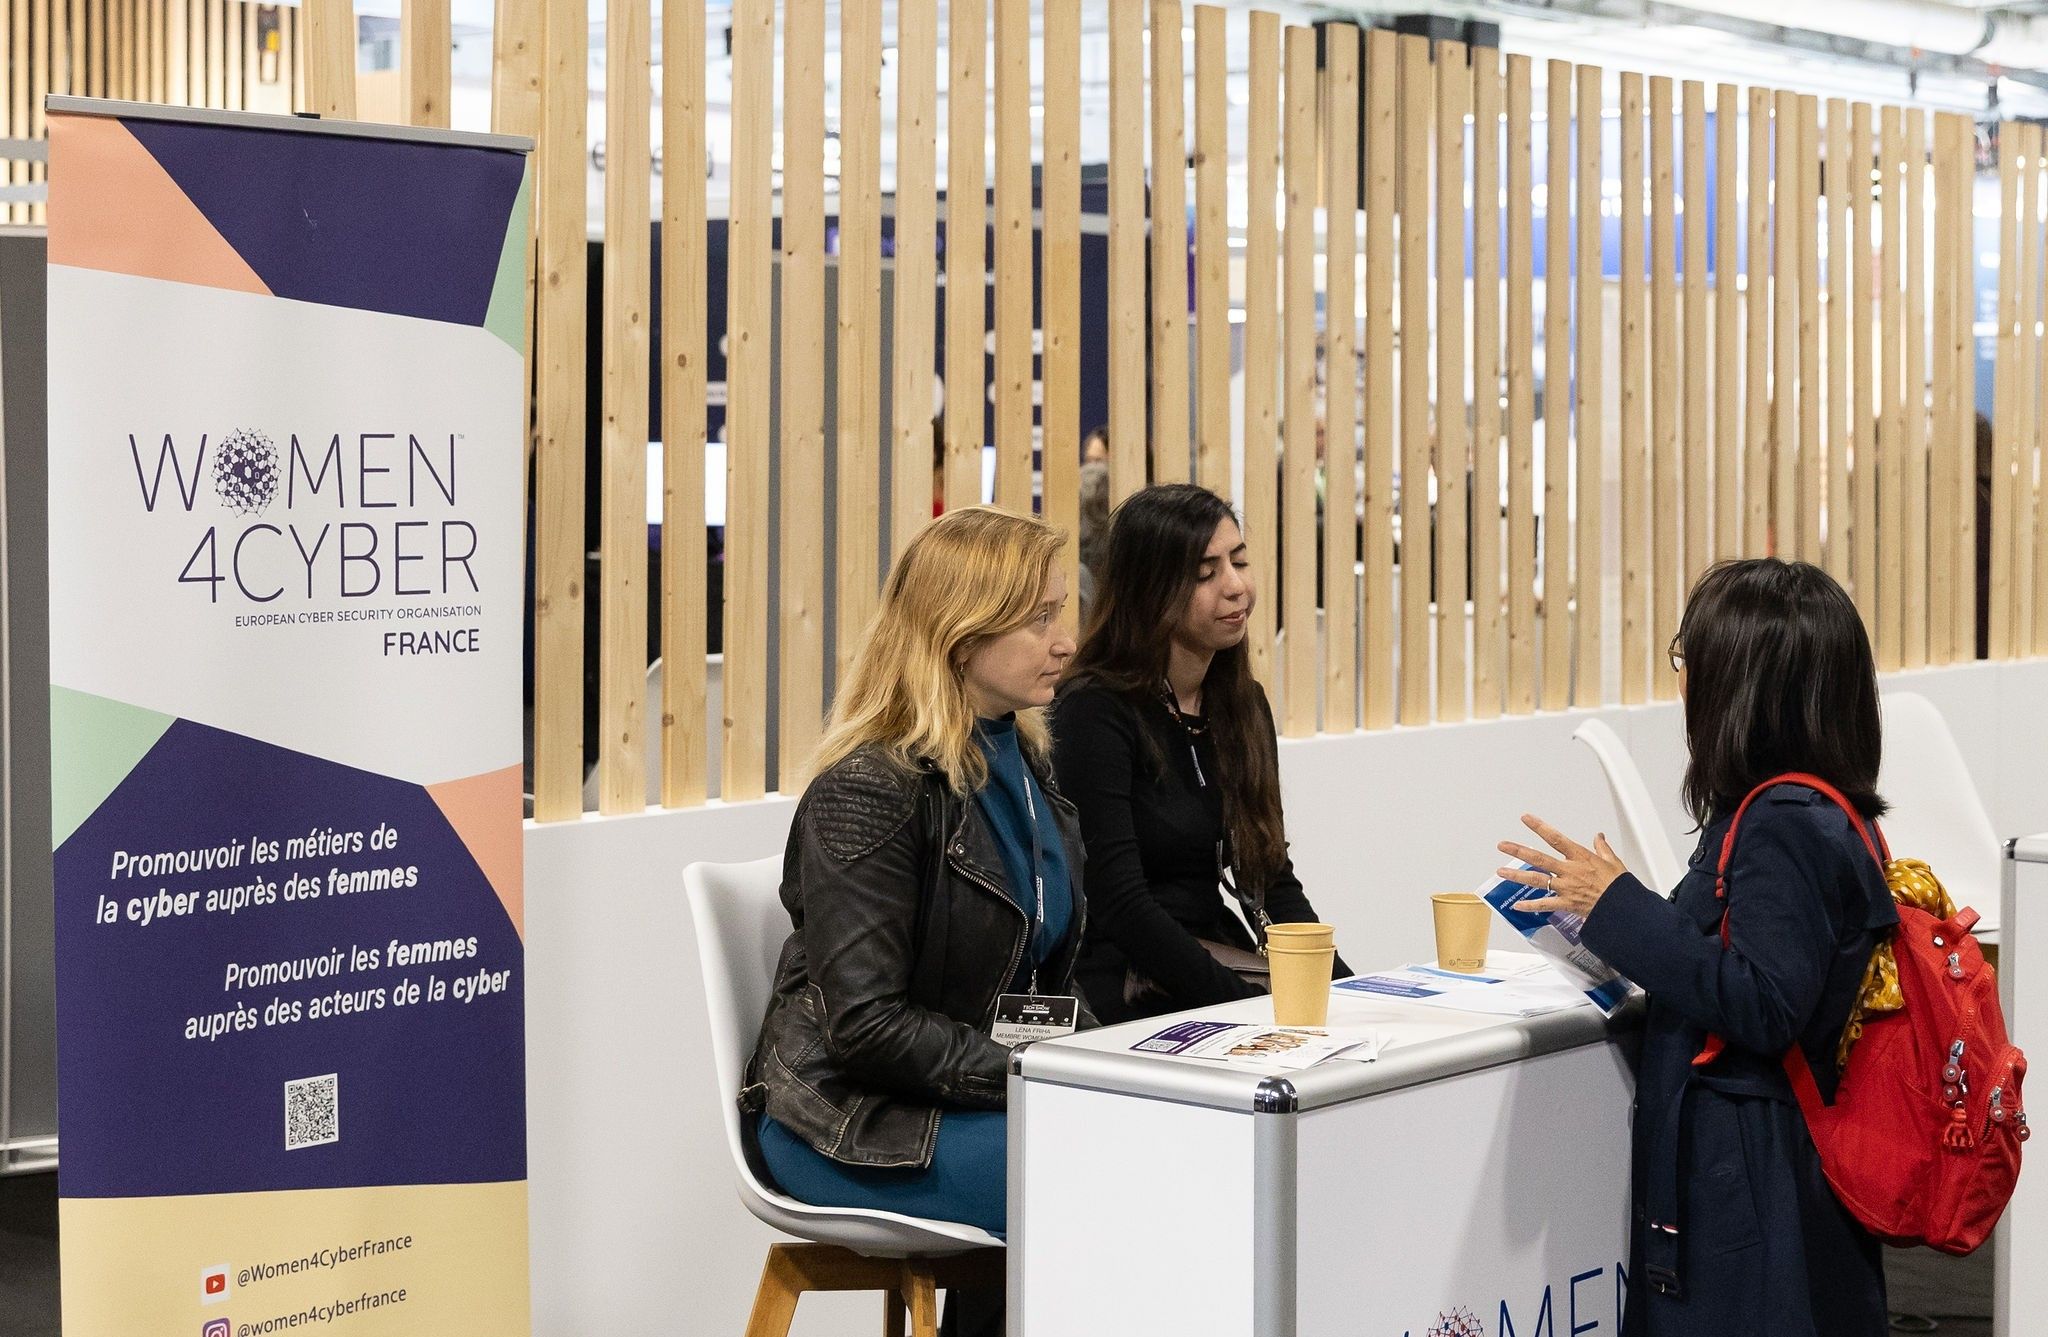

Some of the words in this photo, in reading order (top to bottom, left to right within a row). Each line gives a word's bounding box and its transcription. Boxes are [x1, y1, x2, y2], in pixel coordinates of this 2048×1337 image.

[178, 521, 478, 603] 4CYBER
[236, 614, 295, 626] EUROPEAN
[299, 612, 333, 623] CYBER
[338, 610, 393, 621] SECURITY
[397, 606, 481, 618] ORGANISATION
[384, 629, 479, 656] FRANCE
[112, 839, 245, 879] Promouvoir
[251, 837, 279, 864] les
[286, 828, 363, 860] métiers
[371, 823, 397, 850] de
[97, 895, 118, 923] la
[127, 888, 199, 926] cyber
[206, 876, 276, 914] auprès
[284, 873, 320, 901] des
[328, 866, 418, 895] femmes
[225, 947, 344, 992] Promouvoir
[351, 945, 379, 972] les
[387, 937, 477, 967] femmes
[185, 1002, 257, 1041] auprès
[265, 999, 302, 1026] des
[309, 988, 385, 1019] acteurs
[393, 979, 420, 1005] de
[428, 975, 445, 1002] la
[453, 968, 510, 1003] cyber
[238, 1236, 411, 1287] @Women4CyberFrance
[238, 1289, 406, 1337] @women4cyberfrance
